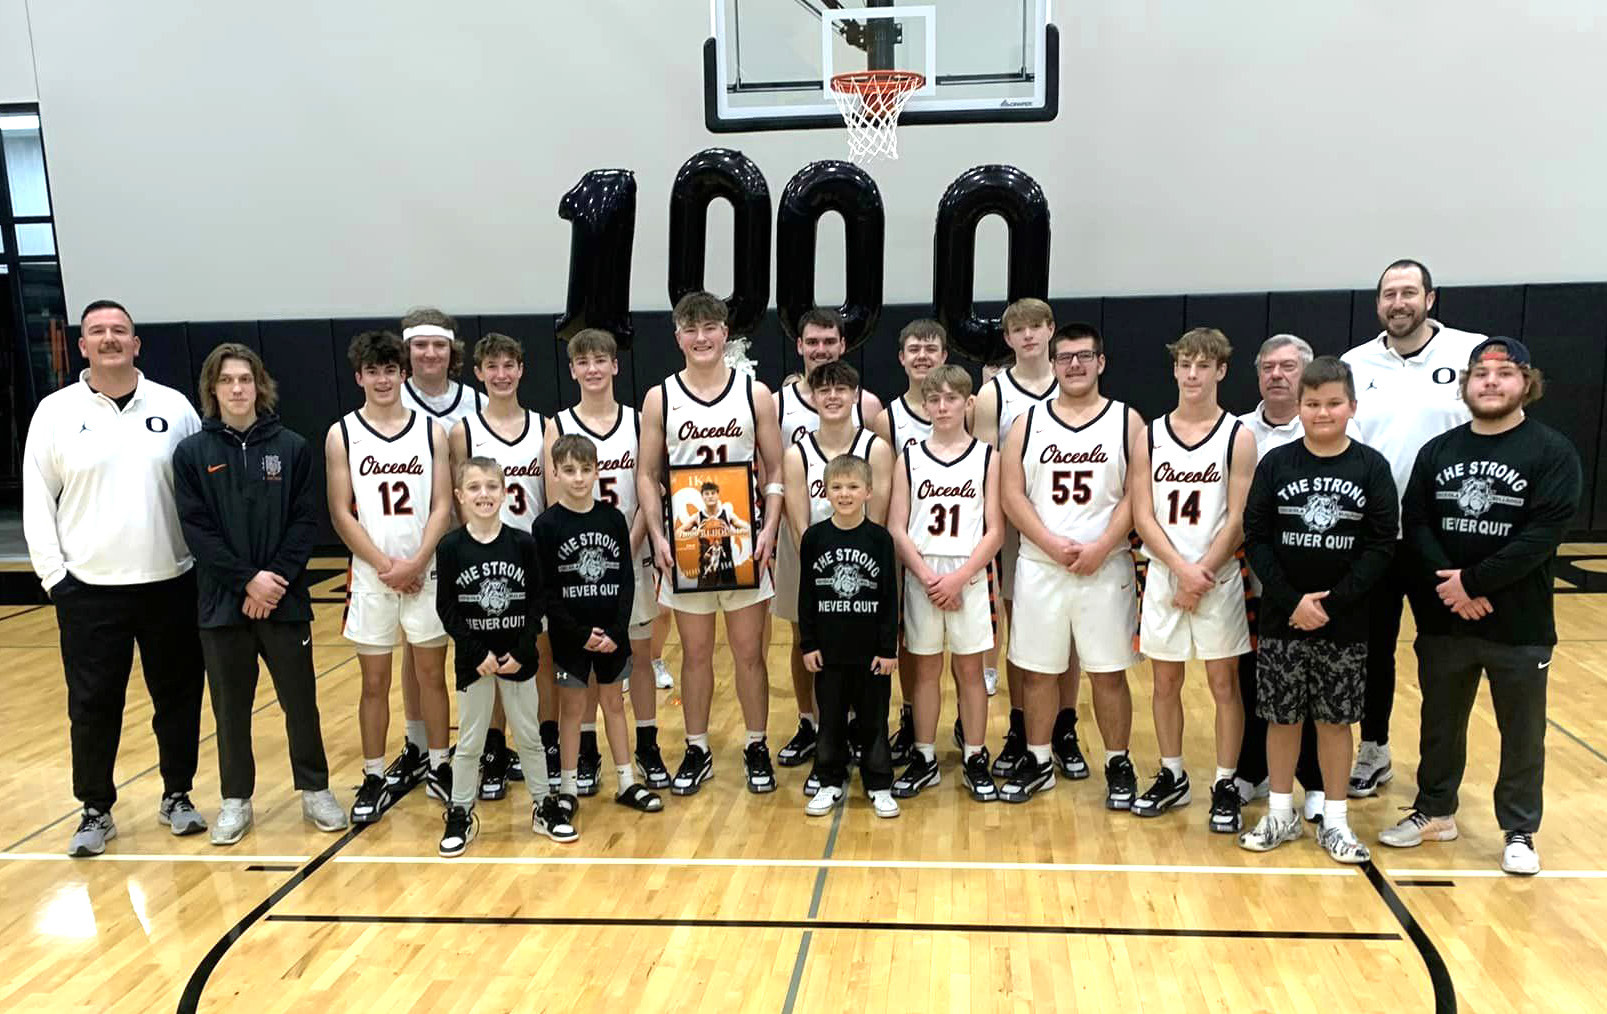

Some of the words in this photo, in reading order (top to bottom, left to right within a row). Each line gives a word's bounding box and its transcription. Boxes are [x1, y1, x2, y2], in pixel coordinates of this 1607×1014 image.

[1432, 367, 1456, 385] O
[145, 416, 169, 433] O
[678, 417, 743, 441] Osceola
[359, 454, 424, 476] Osceola
[597, 450, 635, 471] ceola
[1040, 444, 1108, 464] Osceola
[504, 457, 542, 477] ceola
[1154, 462, 1221, 483] Osceola
[1435, 462, 1465, 487] THE
[1468, 461, 1528, 492] STRONG
[378, 481, 414, 516] 12
[599, 476, 619, 508] 5
[917, 479, 976, 500] Osceola
[1052, 470, 1094, 505] 55
[1277, 478, 1310, 501] THE
[1313, 477, 1367, 508] STRONG
[505, 482, 527, 516] 3
[1167, 489, 1202, 525] 14
[927, 503, 960, 537] 31
[1478, 522, 1513, 537] QUIT
[579, 532, 620, 558] STRONG
[1282, 531, 1322, 548] NEVER
[1325, 534, 1355, 550] QUIT
[813, 551, 834, 573] THE
[836, 548, 880, 578] STRONG
[456, 566, 480, 589] THE
[562, 585, 597, 598] NEVER
[818, 600, 851, 613] NEVER
[853, 601, 879, 613] QUIT
[502, 615, 525, 629] QUIT
